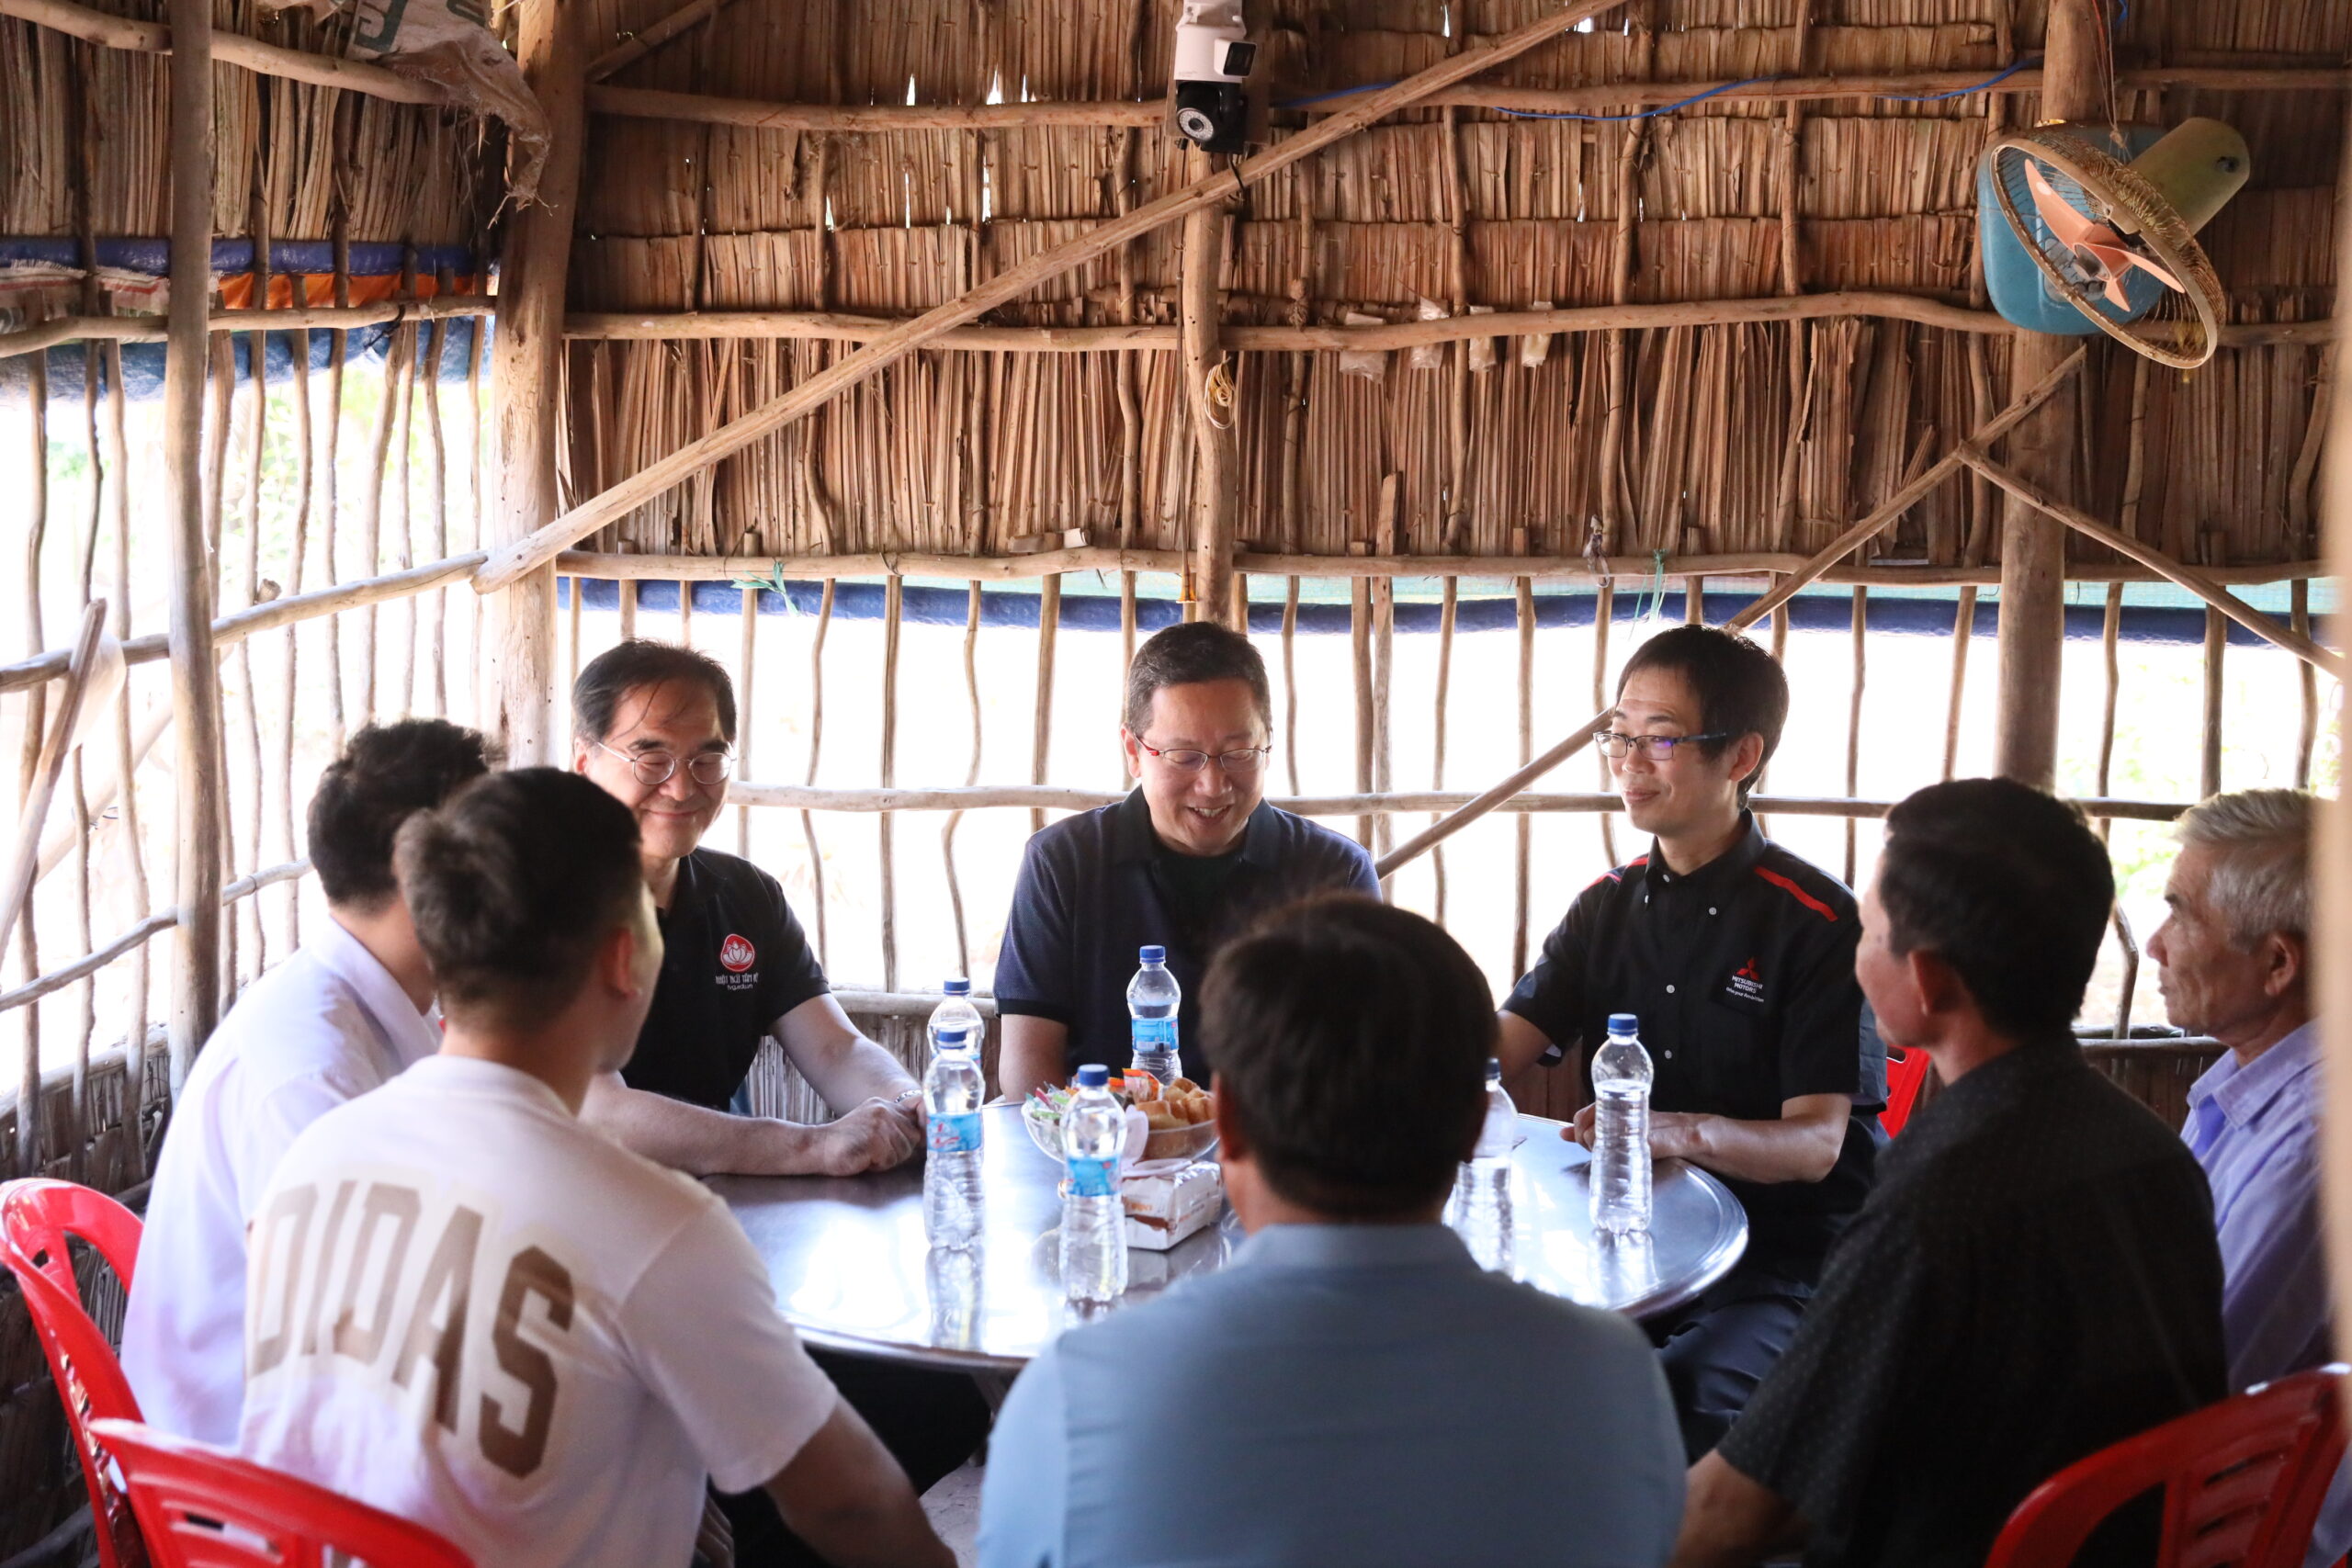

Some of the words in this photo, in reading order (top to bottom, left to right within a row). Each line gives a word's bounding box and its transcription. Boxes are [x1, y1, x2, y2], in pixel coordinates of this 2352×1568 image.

[1732, 975, 1763, 989] MITSUBISHI
[1734, 982, 1757, 994] MOTORS
[246, 1179, 576, 1481] DIDAS
